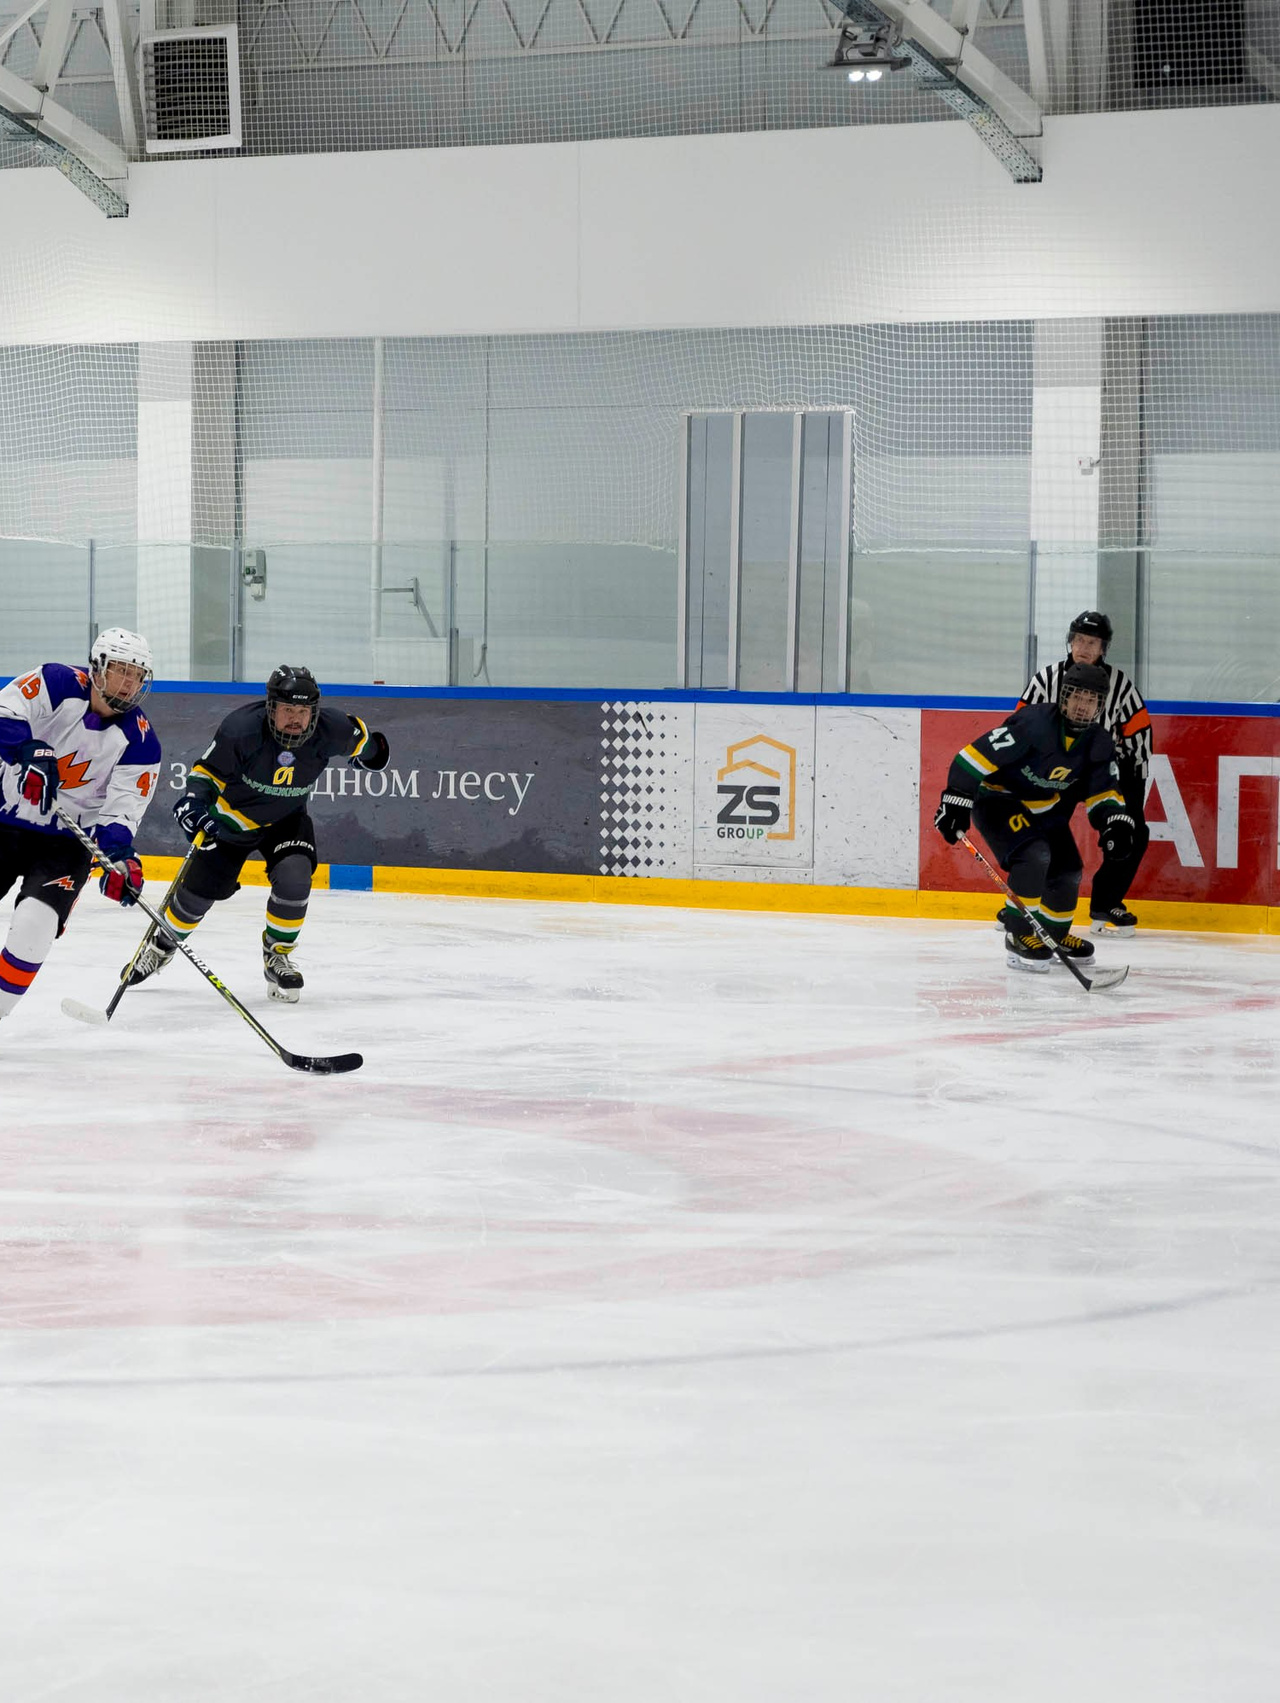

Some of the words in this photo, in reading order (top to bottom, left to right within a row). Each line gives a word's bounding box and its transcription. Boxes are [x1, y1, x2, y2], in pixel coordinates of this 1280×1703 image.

[987, 726, 1017, 752] 47
[432, 769, 536, 816] лесу
[716, 784, 781, 826] ZS
[716, 826, 764, 840] GROUP
[1023, 907, 1058, 950] TRUE
[176, 940, 210, 974] ALPHA
